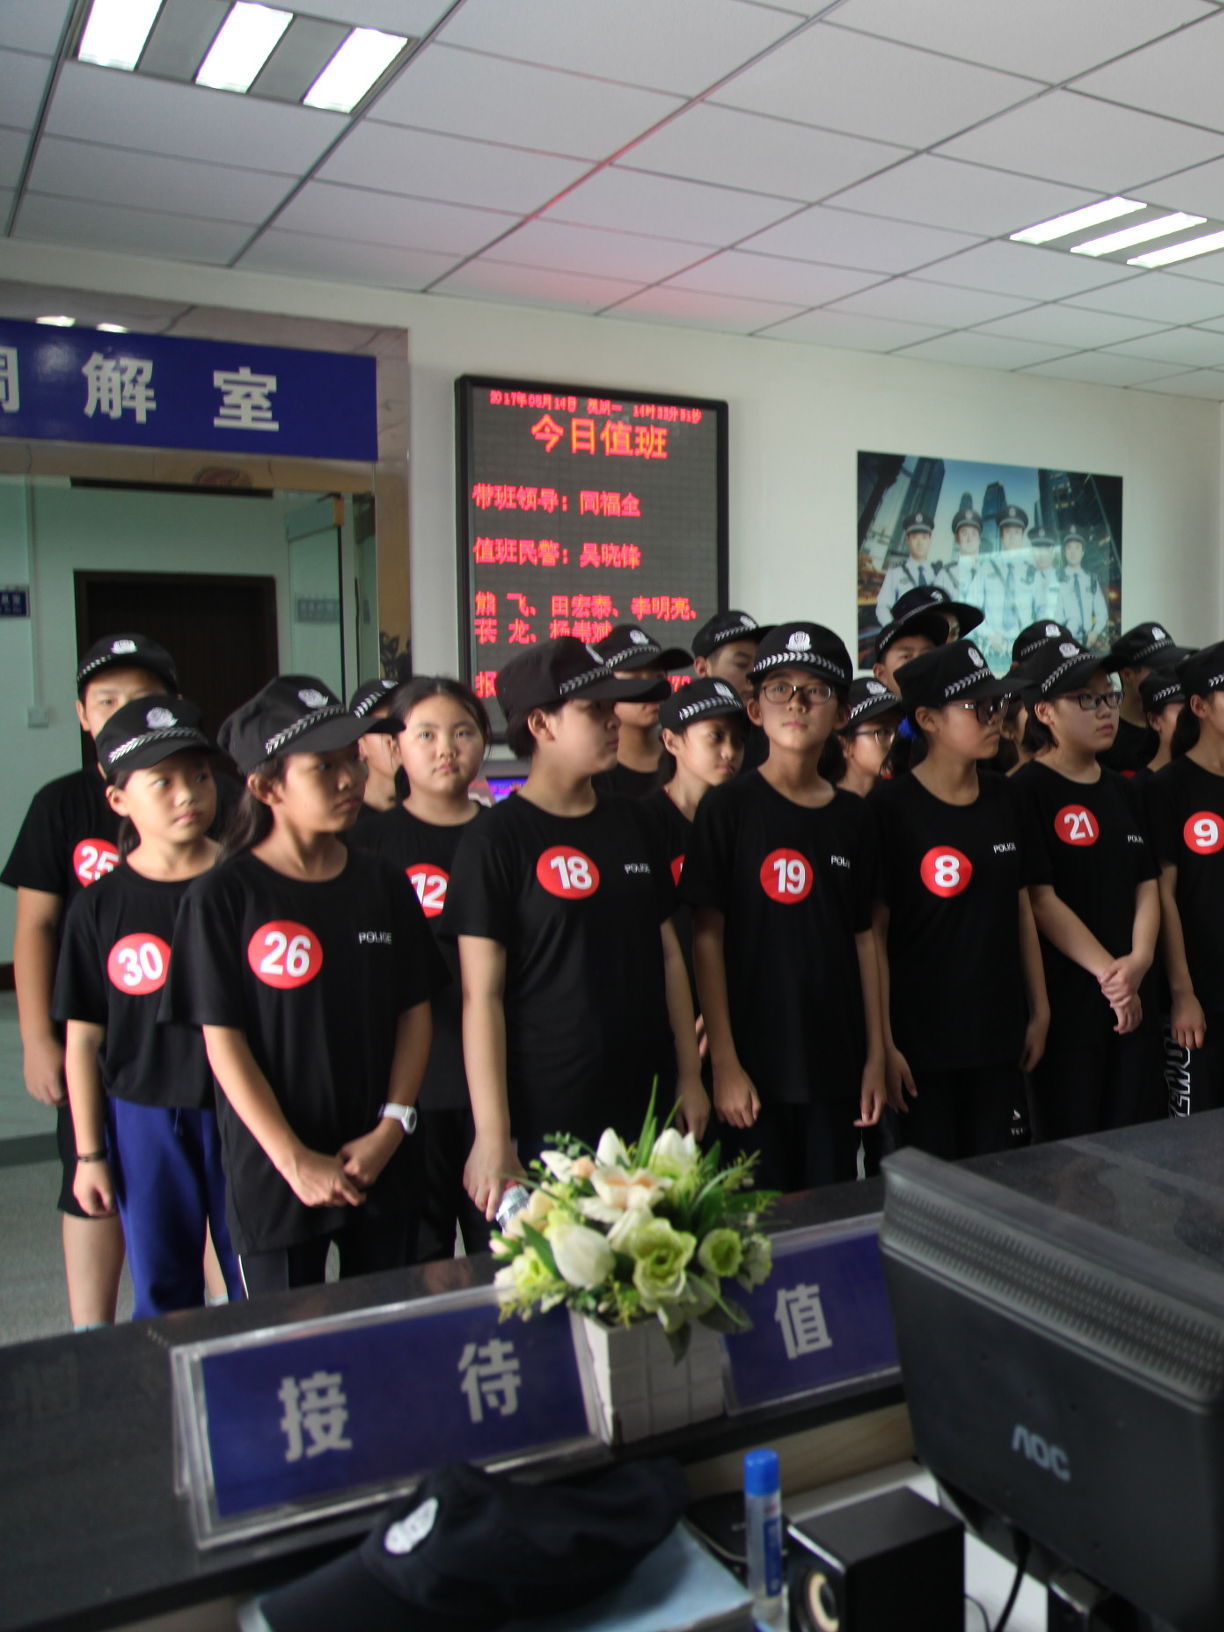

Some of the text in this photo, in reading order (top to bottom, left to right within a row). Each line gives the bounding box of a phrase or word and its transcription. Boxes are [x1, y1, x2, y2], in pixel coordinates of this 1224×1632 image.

[0, 345, 279, 432] 解室
[530, 413, 668, 459] 今日值班
[1063, 811, 1094, 841] 21
[1193, 818, 1219, 847] 9
[78, 846, 121, 882] 25
[550, 855, 593, 890] 18
[773, 858, 806, 894] 19
[934, 855, 960, 888] 8
[411, 872, 448, 910] 12
[118, 942, 164, 988] 30
[260, 931, 312, 978] 26
[774, 1283, 833, 1360] 值
[277, 1338, 522, 1463] 接待
[1011, 1423, 1071, 1483] AOC
